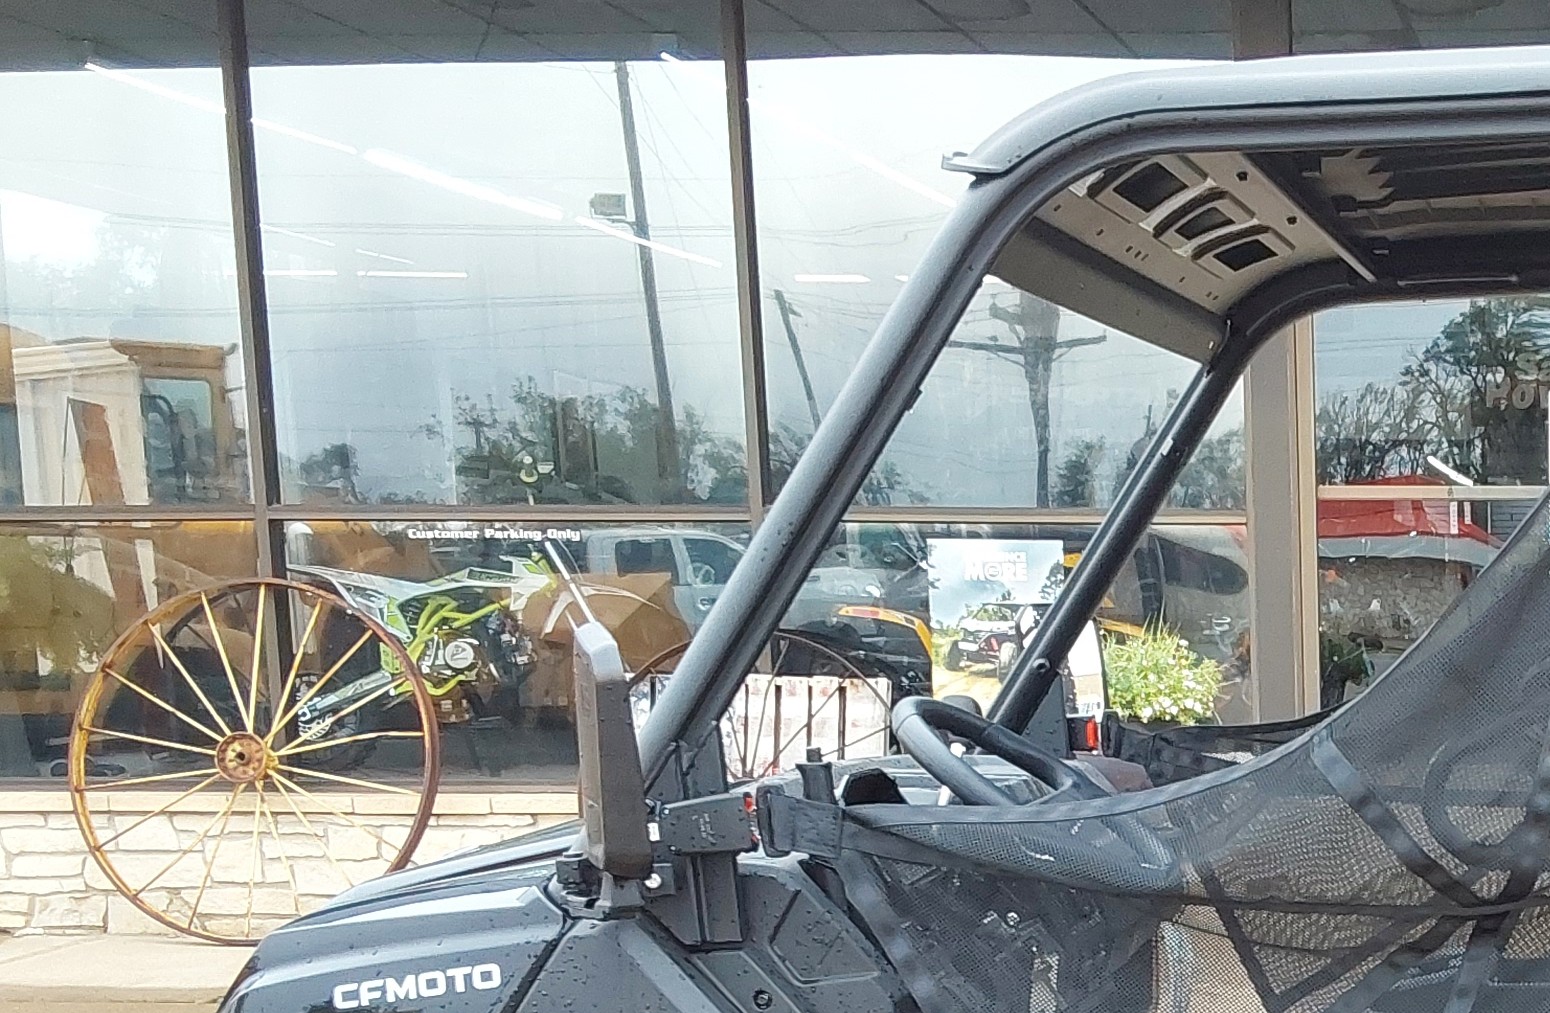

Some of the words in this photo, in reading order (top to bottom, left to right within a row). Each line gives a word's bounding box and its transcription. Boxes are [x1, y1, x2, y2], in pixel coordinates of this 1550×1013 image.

[407, 528, 479, 540] Customer
[484, 528, 542, 541] Parking
[547, 528, 581, 541] Only
[332, 962, 501, 1010] CFMOTO
